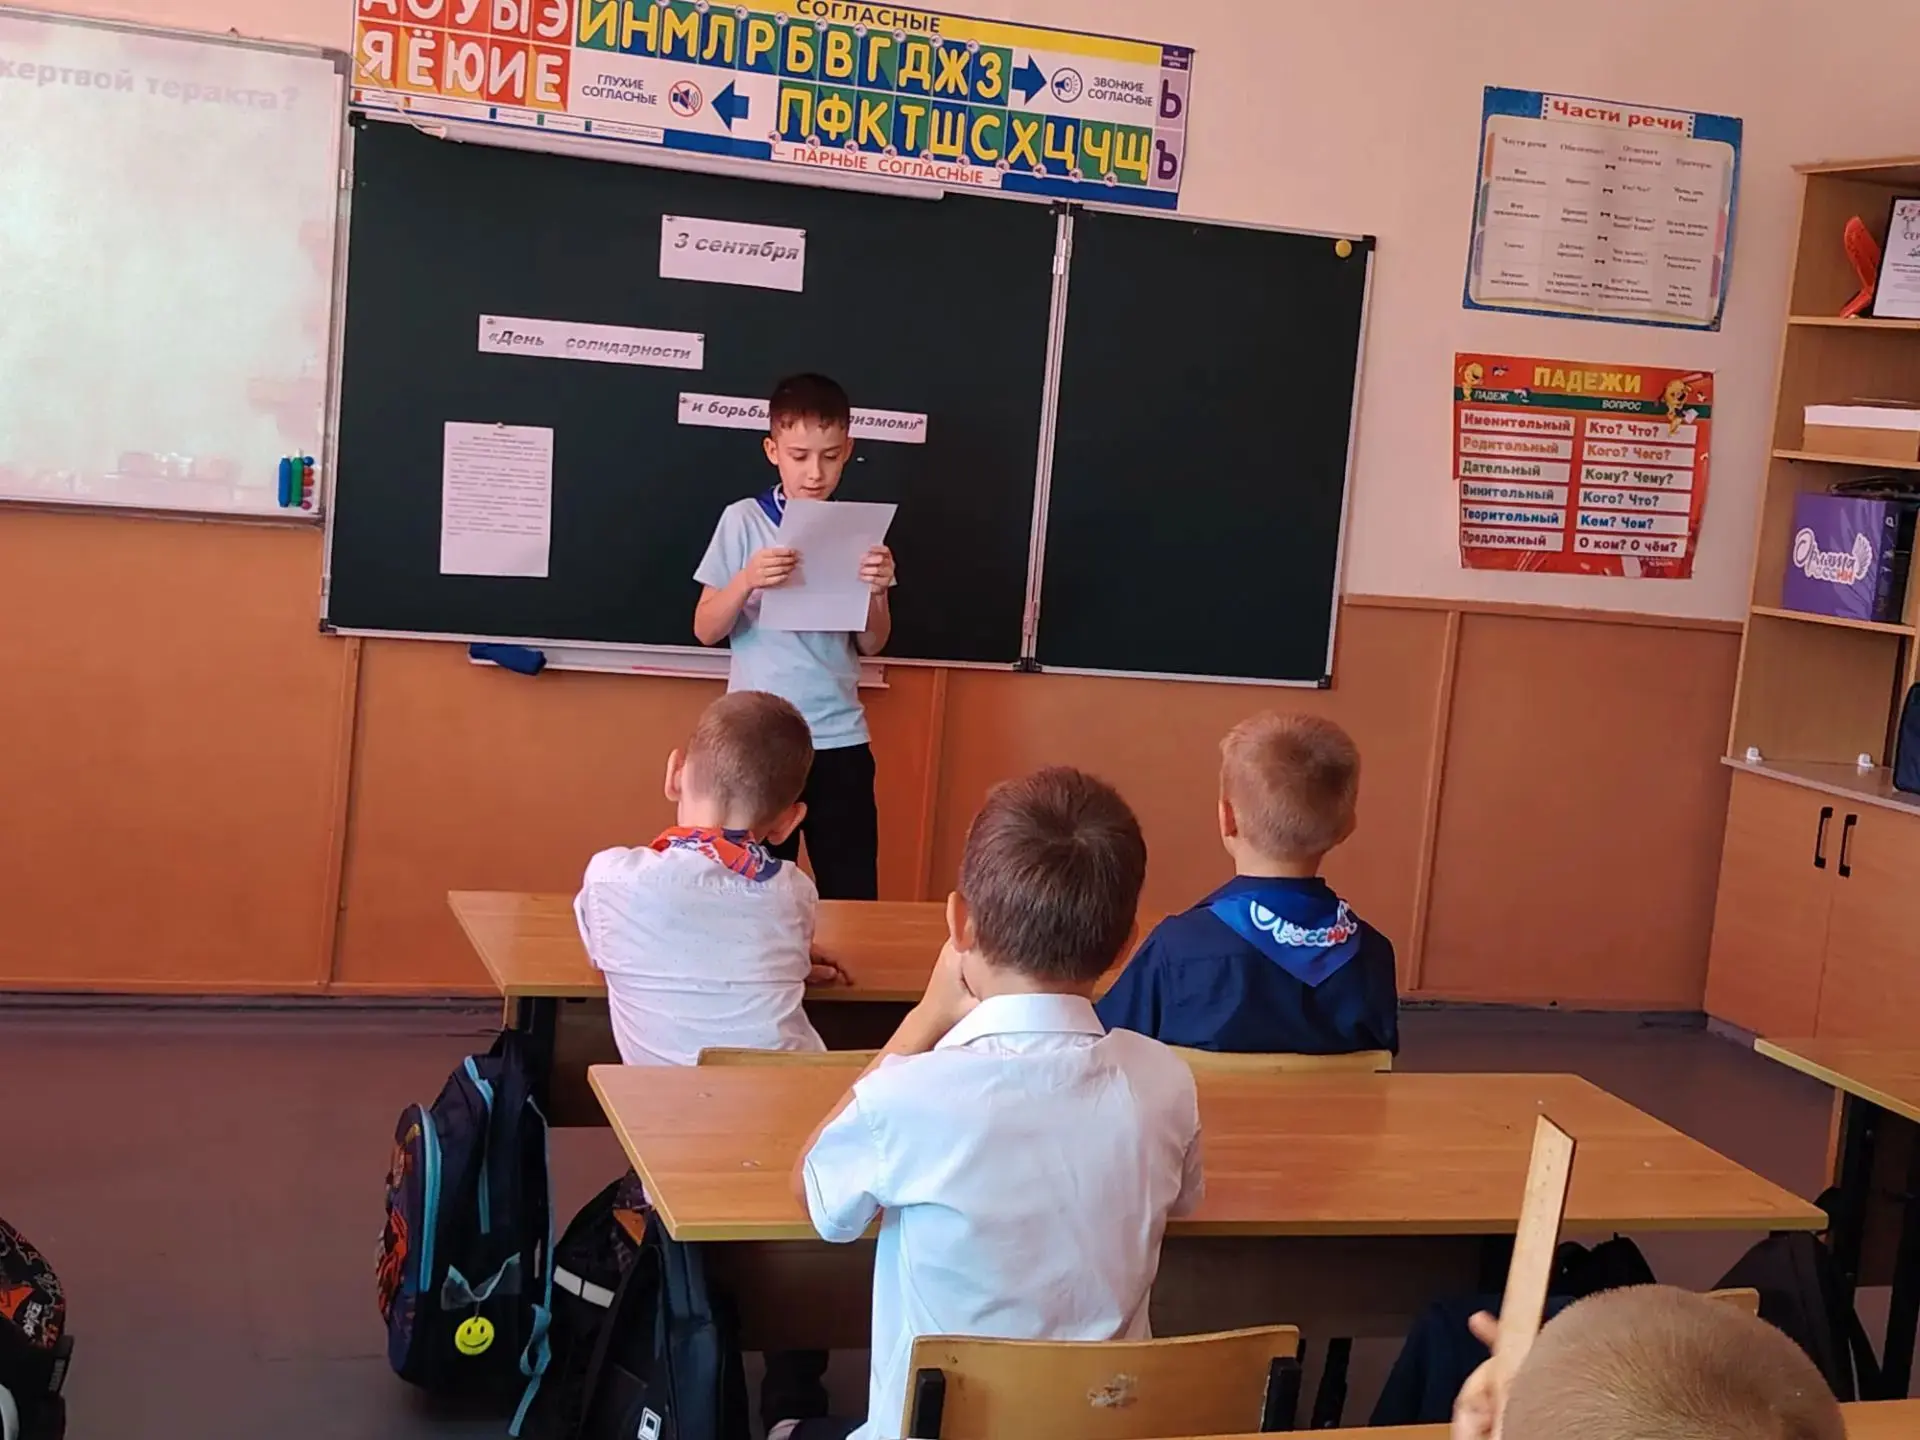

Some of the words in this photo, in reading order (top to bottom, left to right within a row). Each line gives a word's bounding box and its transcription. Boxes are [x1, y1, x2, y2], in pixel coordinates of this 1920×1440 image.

[796, 0, 941, 33] СОГЛАСНЫЕ
[597, 74, 645, 91] ГЛУХИЕ
[1093, 77, 1145, 94] ЗВОНКИЕ
[146, 75, 299, 111] теракта?
[581, 85, 658, 106] СОГЛАСНЫЕ
[1087, 87, 1153, 107] СОГЛАСНЫЕ
[1552, 101, 1621, 122] Части
[1627, 113, 1684, 131] речи
[792, 147, 868, 170] ПАРНЫЕ
[877, 158, 984, 184] СОГЛАСНЫЕ
[674, 232, 690, 249] 3
[695, 238, 800, 262] сентября
[488, 330, 545, 347] «День
[565, 337, 692, 360] солидарности
[1533, 366, 1642, 393] ПАДЕЖИ
[691, 402, 703, 413] и
[1474, 390, 1509, 401] ПАДЕЖ
[1602, 399, 1642, 411] ВОПРОС
[1464, 413, 1571, 431] Именительный
[1589, 421, 1622, 435] Кто?
[1628, 424, 1659, 437] Что?
[1463, 437, 1559, 454] Родительный
[1587, 444, 1629, 458] Кого?
[1633, 446, 1671, 461] Чего?
[1462, 460, 1541, 476] Дательный
[1585, 468, 1629, 484] Кому?
[1633, 469, 1674, 486] Чему?
[1463, 481, 1554, 500] Винительный
[1583, 491, 1624, 504] Кого?
[1629, 493, 1659, 506] Что?
[1463, 507, 1559, 524] Творительный
[1580, 514, 1617, 527] Кем?
[1621, 516, 1654, 529] Чем?
[1463, 531, 1547, 547] Предложный
[1579, 537, 1589, 548] О
[1593, 539, 1627, 550] ком?
[1630, 539, 1640, 551] О
